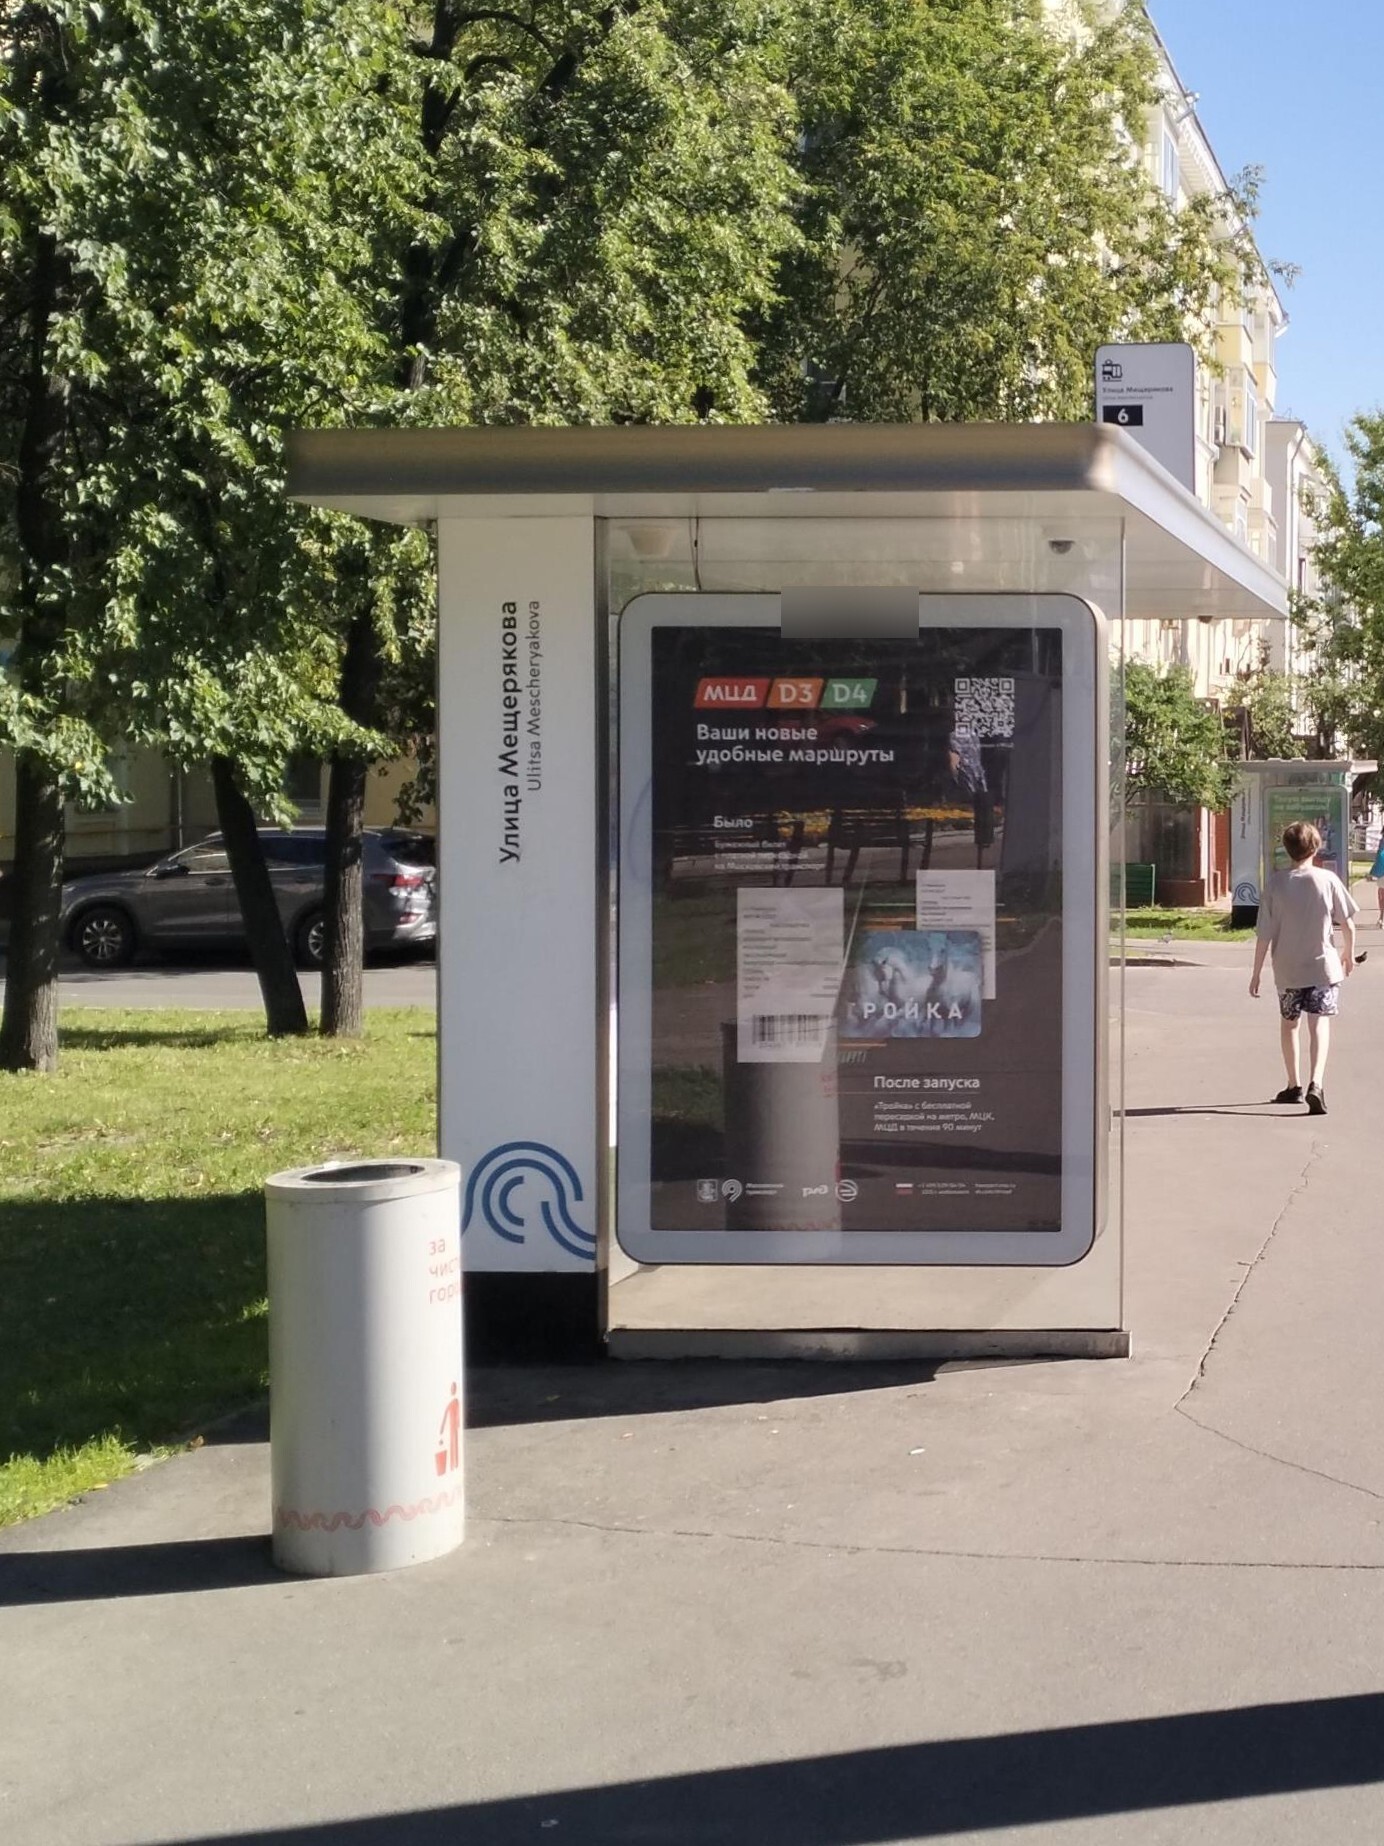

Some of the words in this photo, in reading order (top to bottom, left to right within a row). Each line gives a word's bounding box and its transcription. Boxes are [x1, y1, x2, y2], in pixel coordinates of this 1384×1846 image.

[1117, 408, 1129, 424] 6
[525, 601, 544, 737] Mescheryakova
[498, 601, 522, 777] Мещерякова
[703, 685, 758, 702] МЦД
[778, 684, 813, 703] D3
[832, 684, 868, 703] D4
[696, 723, 750, 741] Ваши
[755, 727, 818, 741] новые
[696, 745, 784, 766] удобные
[789, 749, 895, 766] маршруты
[526, 741, 542, 792] Ulitsa
[499, 784, 522, 864] Улица
[713, 815, 754, 829] Было
[873, 1076, 920, 1089] После
[923, 1078, 980, 1091] запуска
[874, 1123, 898, 1132] МЦД
[942, 1123, 954, 1131] 90
[428, 1238, 446, 1256] за
